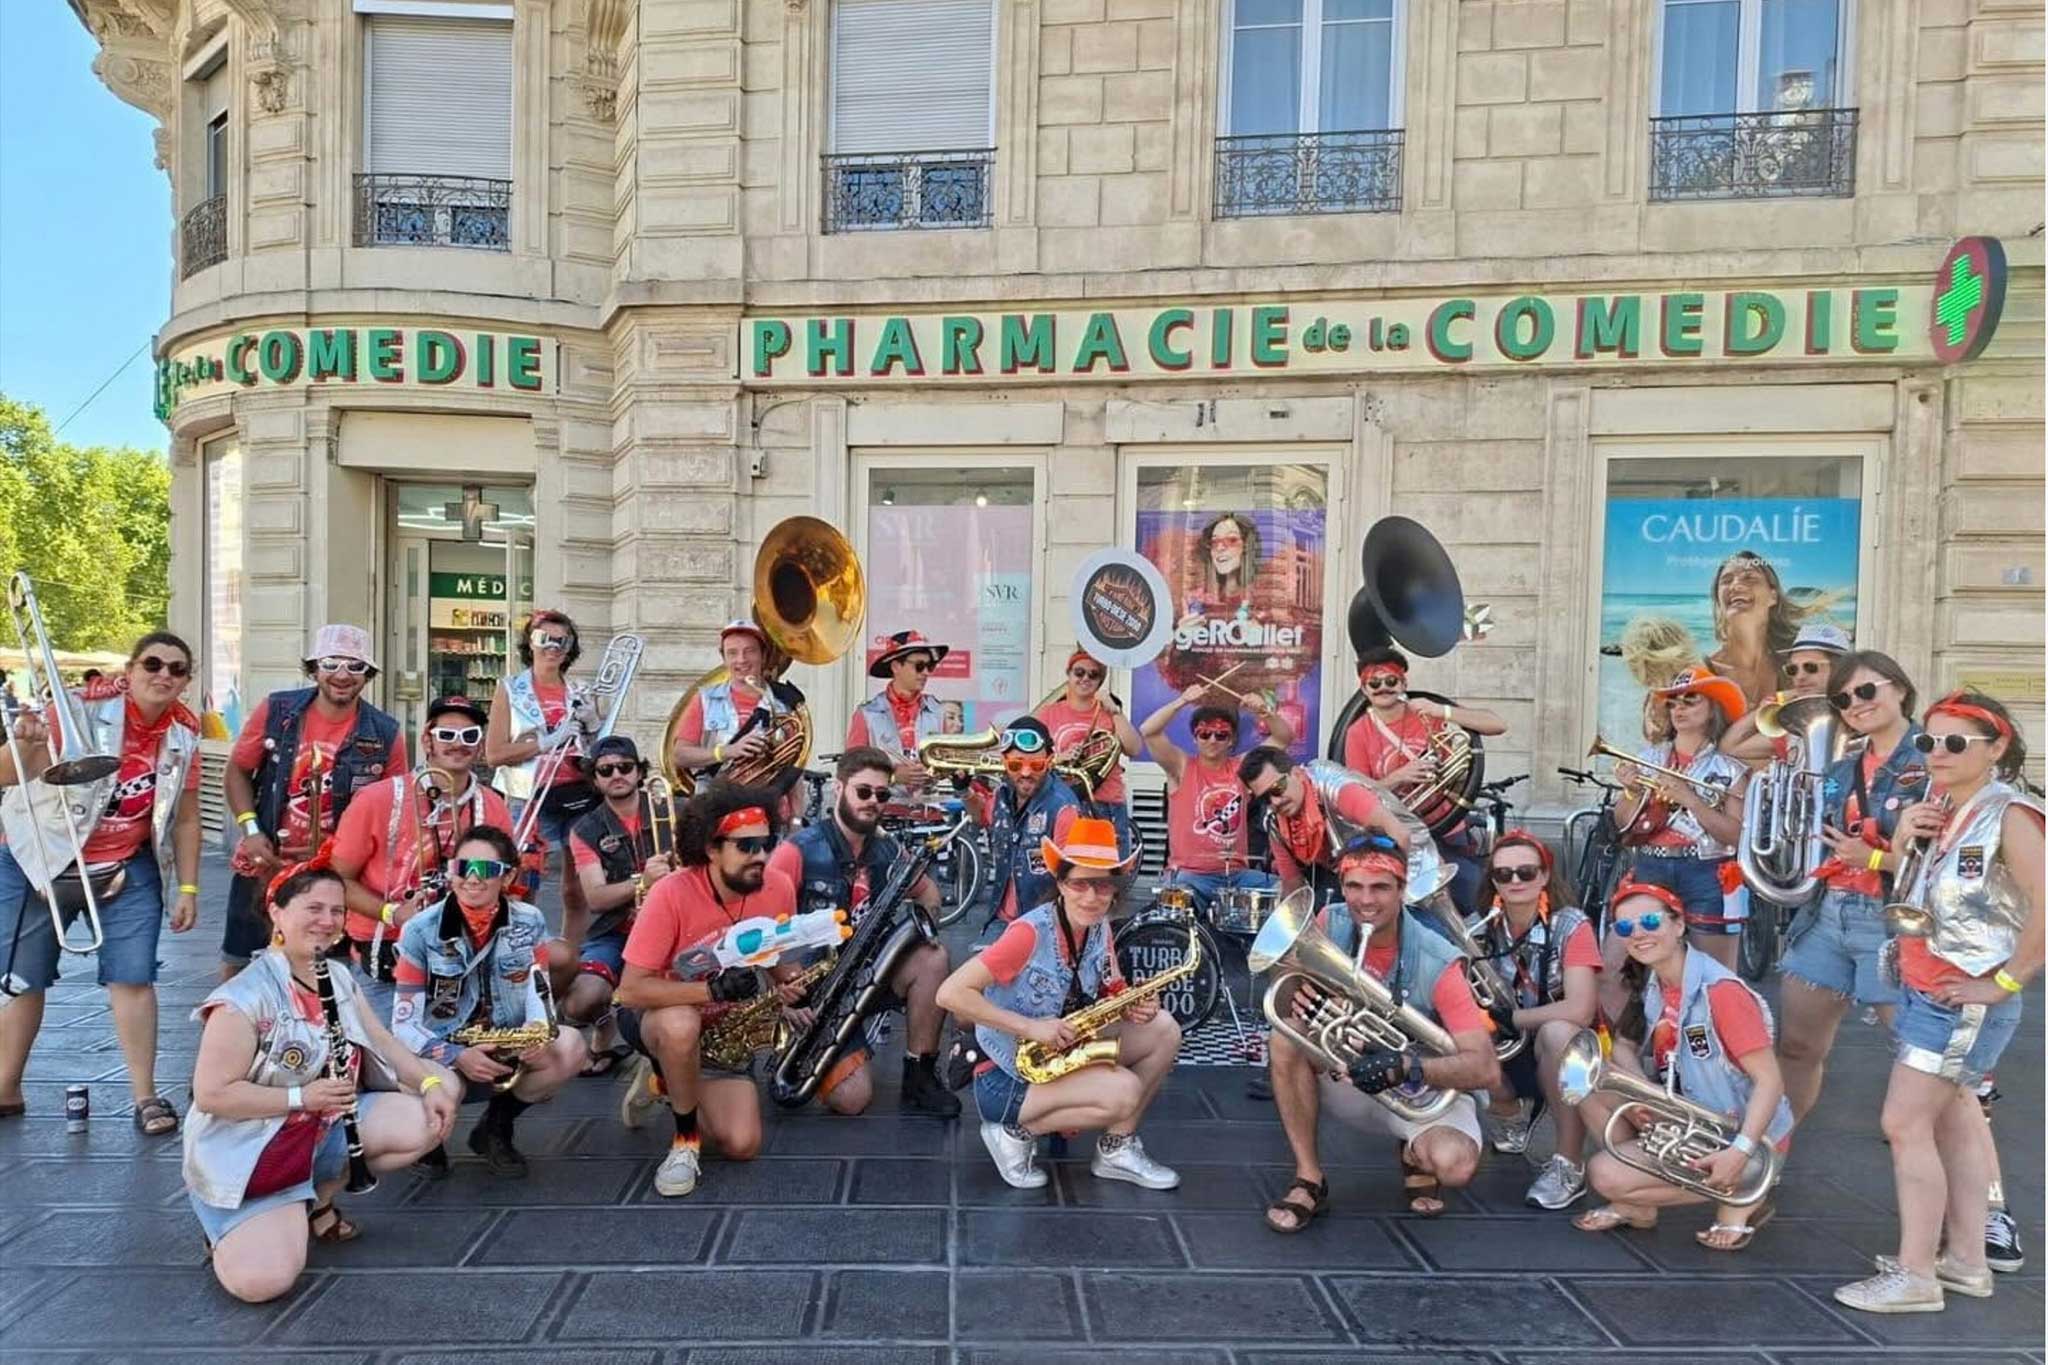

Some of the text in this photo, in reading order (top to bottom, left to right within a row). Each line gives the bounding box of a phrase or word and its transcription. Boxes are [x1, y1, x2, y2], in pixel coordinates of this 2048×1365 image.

[753, 287, 1898, 377] PHARMACIE de la COMEDIE
[226, 329, 542, 391] COMEDIE
[456, 577, 532, 596] MÉDC
[986, 584, 1019, 600] SVR
